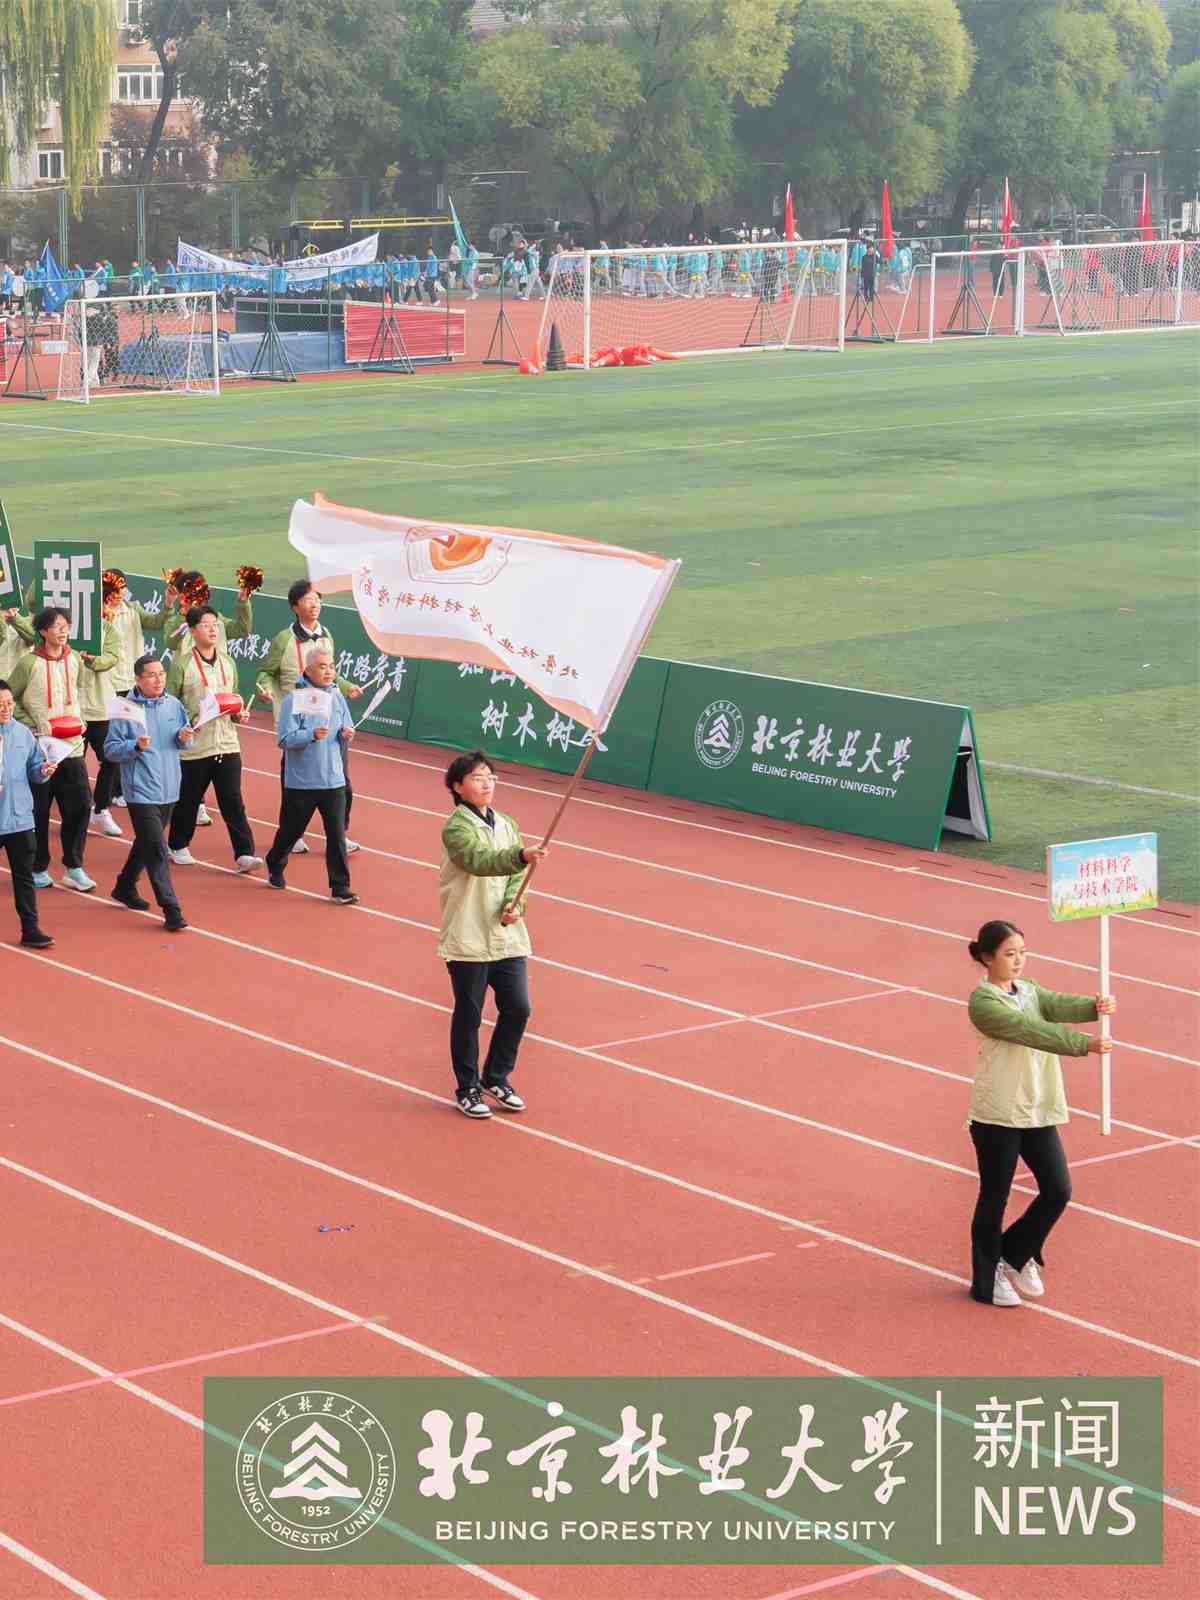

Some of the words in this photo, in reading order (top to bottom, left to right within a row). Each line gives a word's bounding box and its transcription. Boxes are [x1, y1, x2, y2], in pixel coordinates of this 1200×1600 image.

[43, 552, 95, 641] 新
[752, 762, 788, 778] BEIJING
[790, 769, 839, 787] FORESTRY
[840, 779, 897, 798] UNIVERSITY
